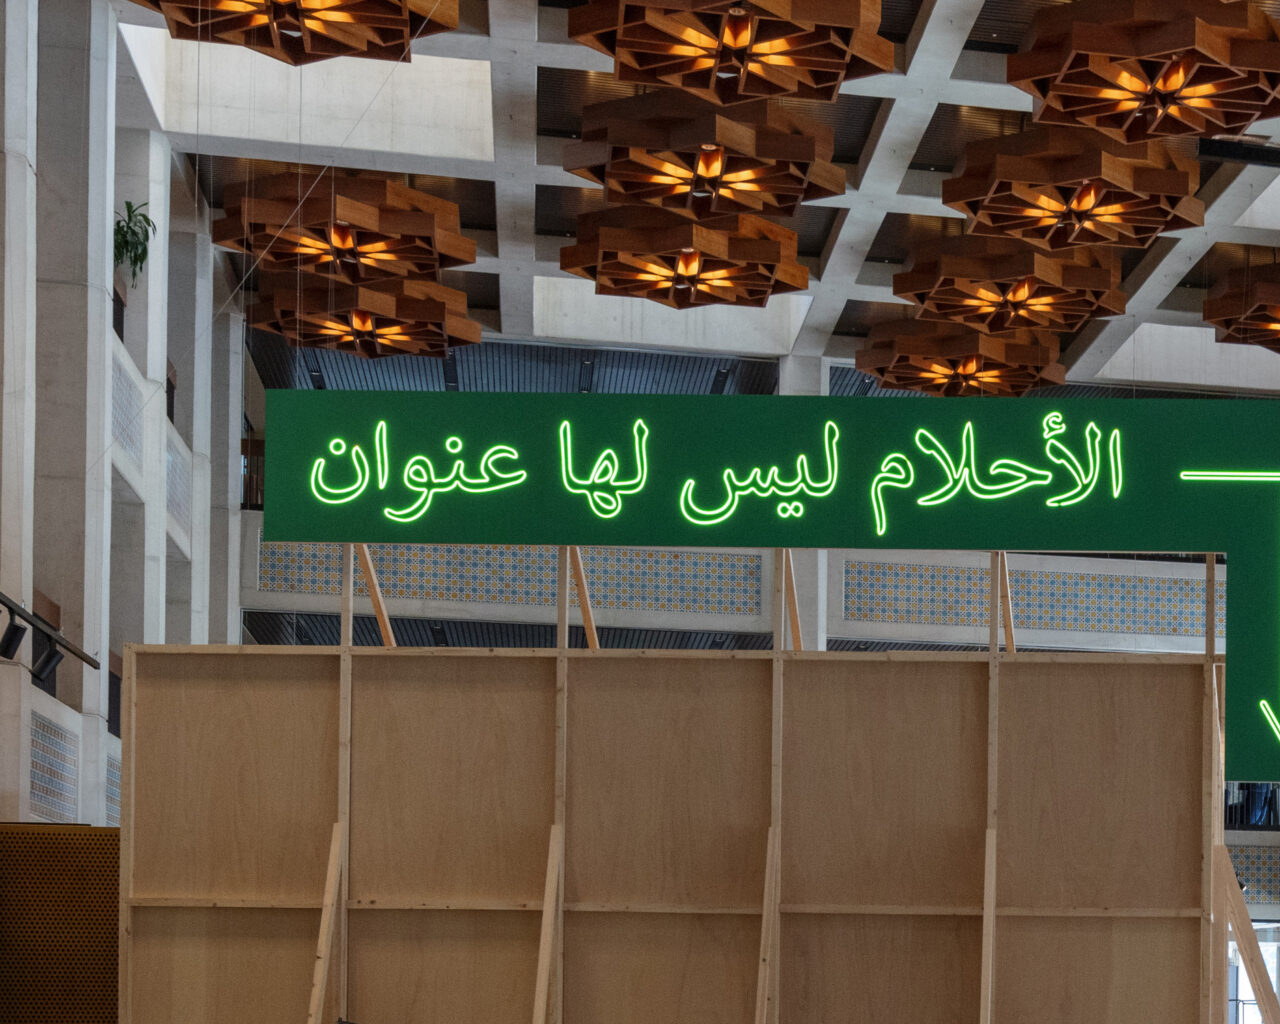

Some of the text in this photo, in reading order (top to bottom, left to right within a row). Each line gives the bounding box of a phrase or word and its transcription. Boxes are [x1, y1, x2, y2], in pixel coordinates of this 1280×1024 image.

[309, 410, 1124, 536] الأحلام ليس لها عنوان
